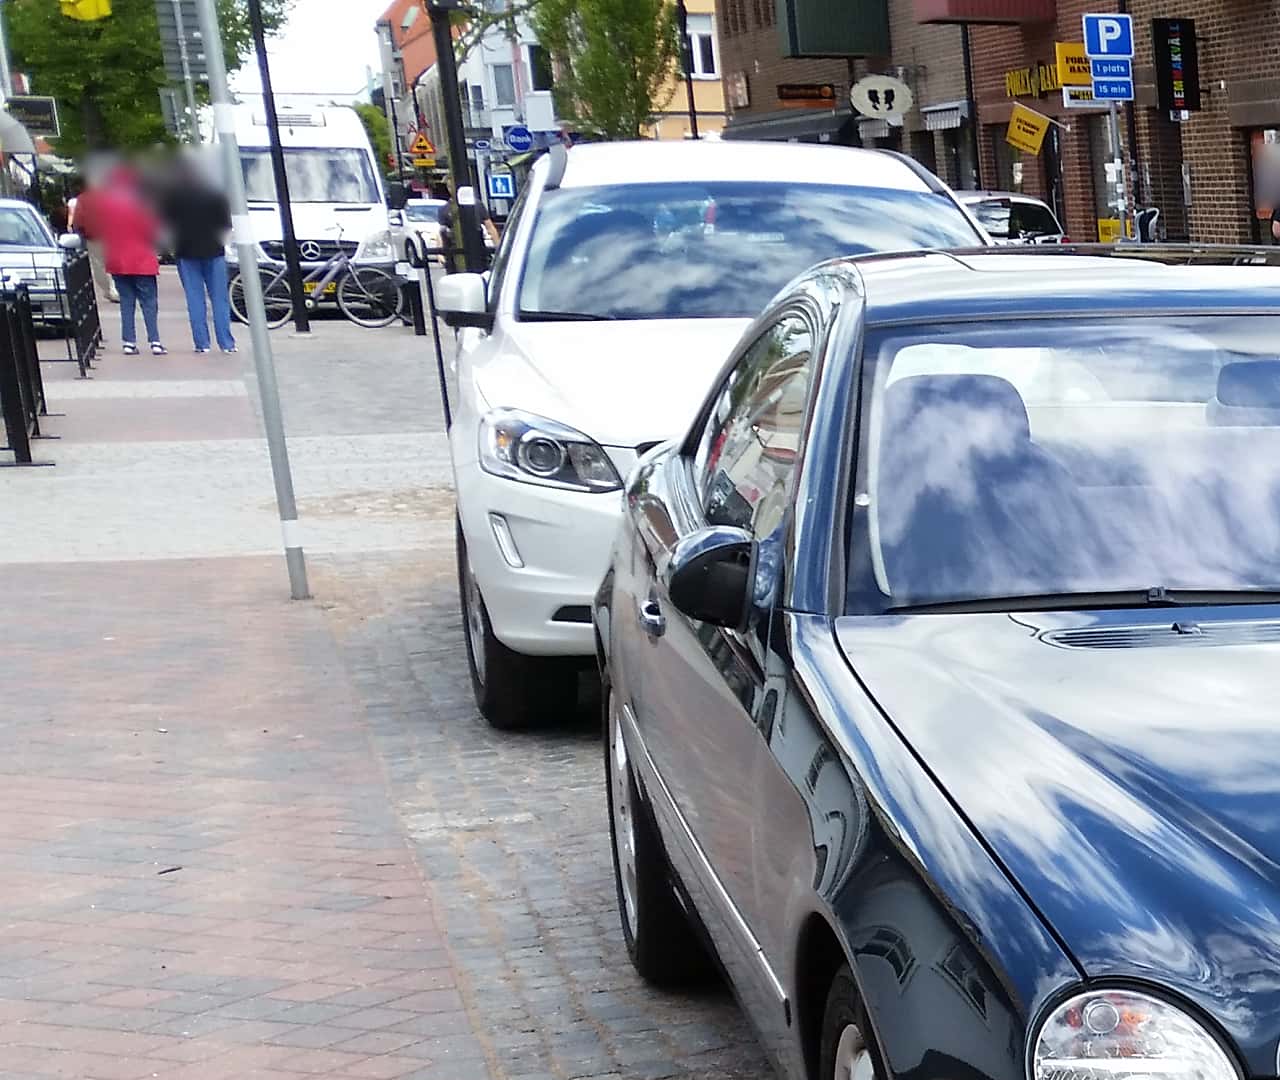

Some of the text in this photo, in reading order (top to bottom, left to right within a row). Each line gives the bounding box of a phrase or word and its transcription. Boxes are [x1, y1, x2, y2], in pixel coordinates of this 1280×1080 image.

[1098, 19, 1121, 53] P
[1096, 63, 1125, 73] 1 plats
[1099, 85, 1126, 93] 15 min
